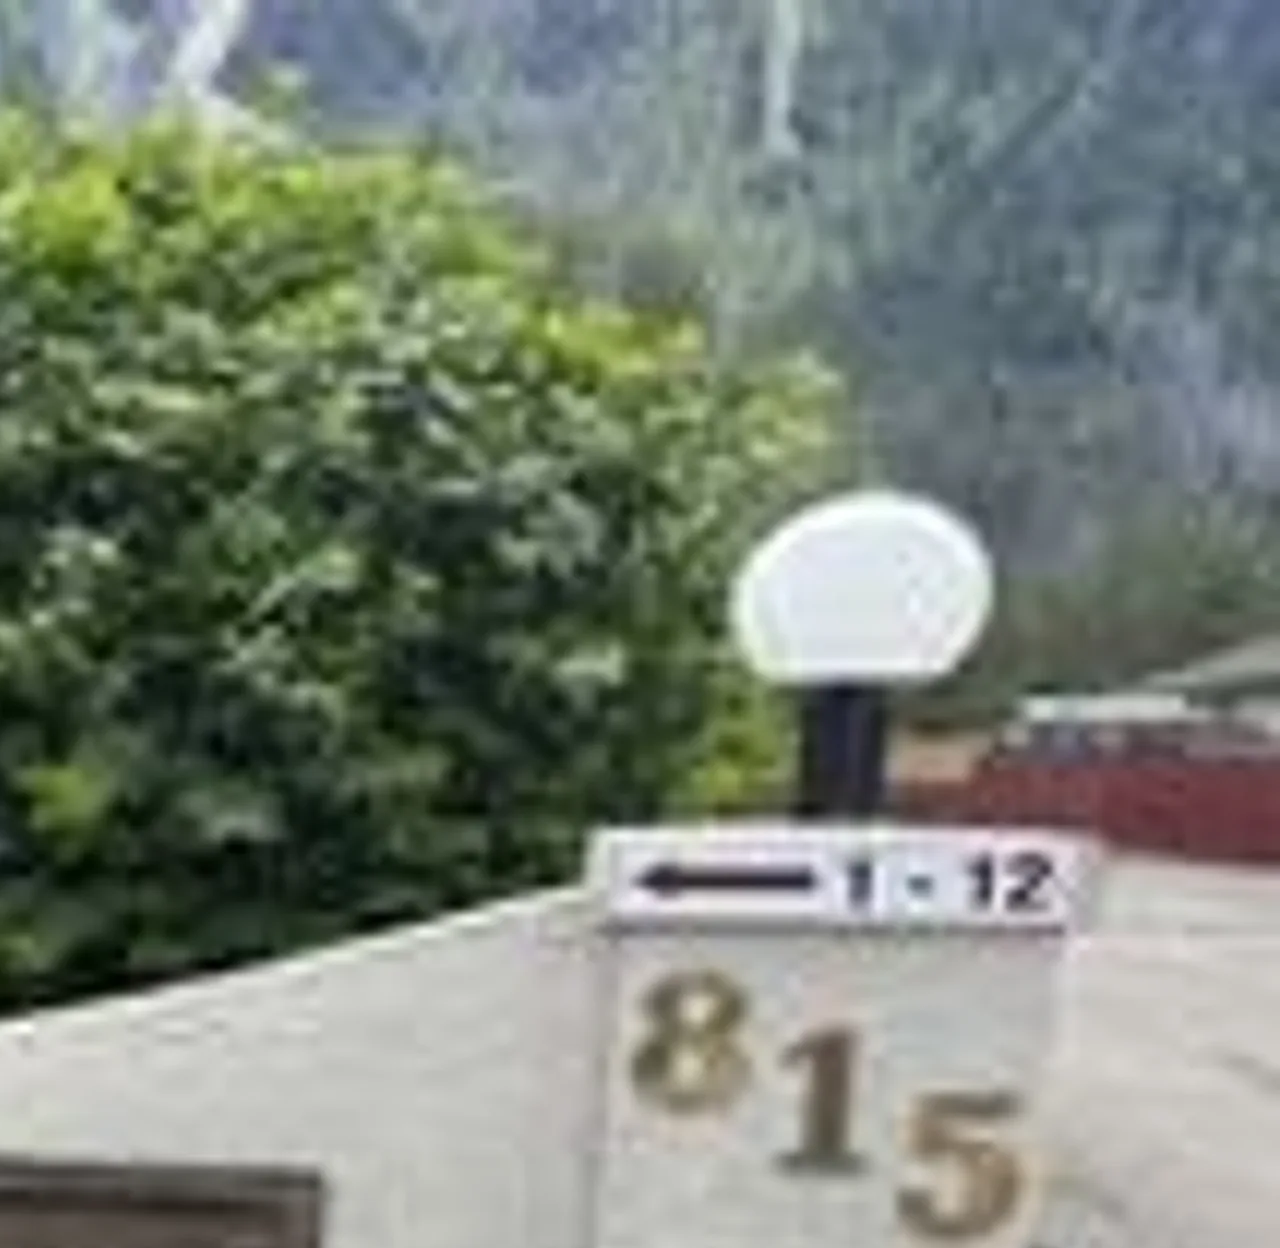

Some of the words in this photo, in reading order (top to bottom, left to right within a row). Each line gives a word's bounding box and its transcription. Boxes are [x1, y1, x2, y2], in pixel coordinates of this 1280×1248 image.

[846, 858, 874, 907] 1
[966, 854, 1053, 911] 12
[630, 967, 1026, 1238] 815
